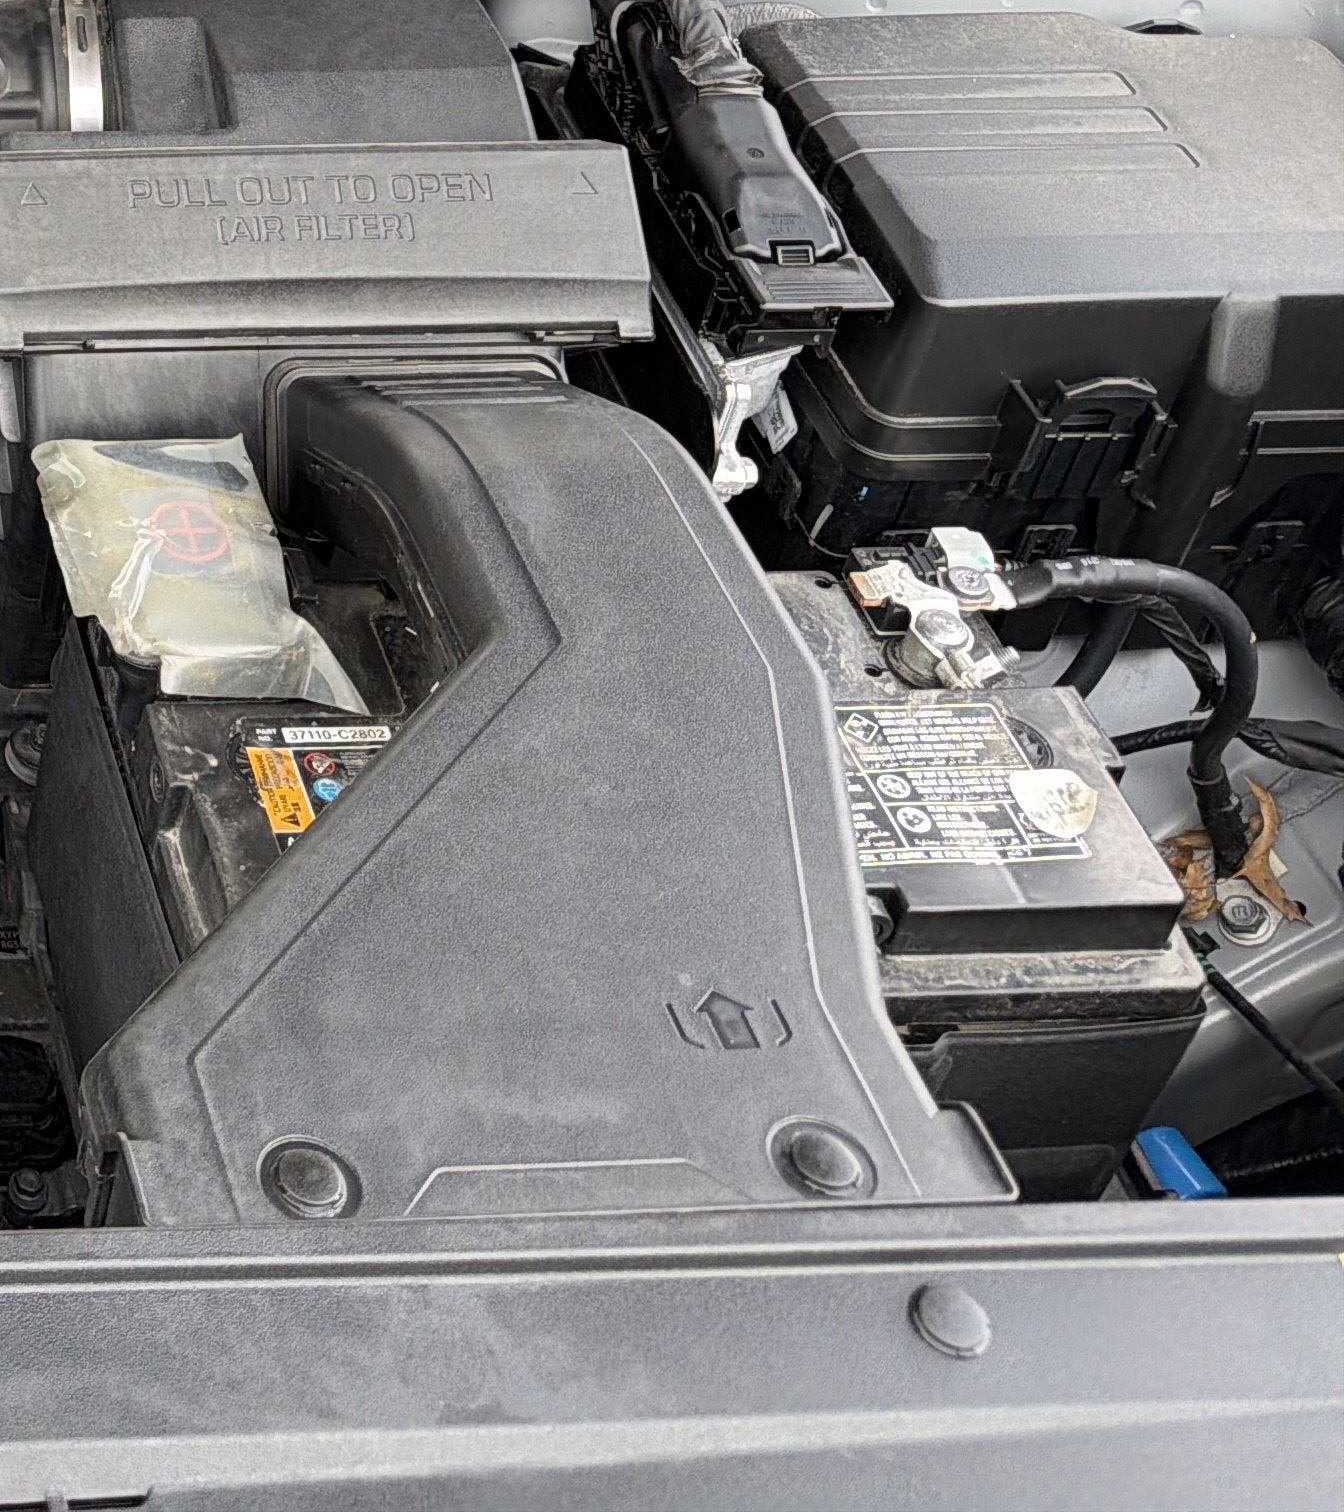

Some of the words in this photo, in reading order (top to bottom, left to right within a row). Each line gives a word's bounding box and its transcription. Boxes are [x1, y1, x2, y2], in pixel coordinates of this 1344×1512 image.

[126, 178, 227, 208] PULL
[236, 176, 315, 207] OUT
[325, 175, 378, 205] TO
[391, 173, 494, 203] OPEN
[289, 729, 386, 740] 37110-C2802
